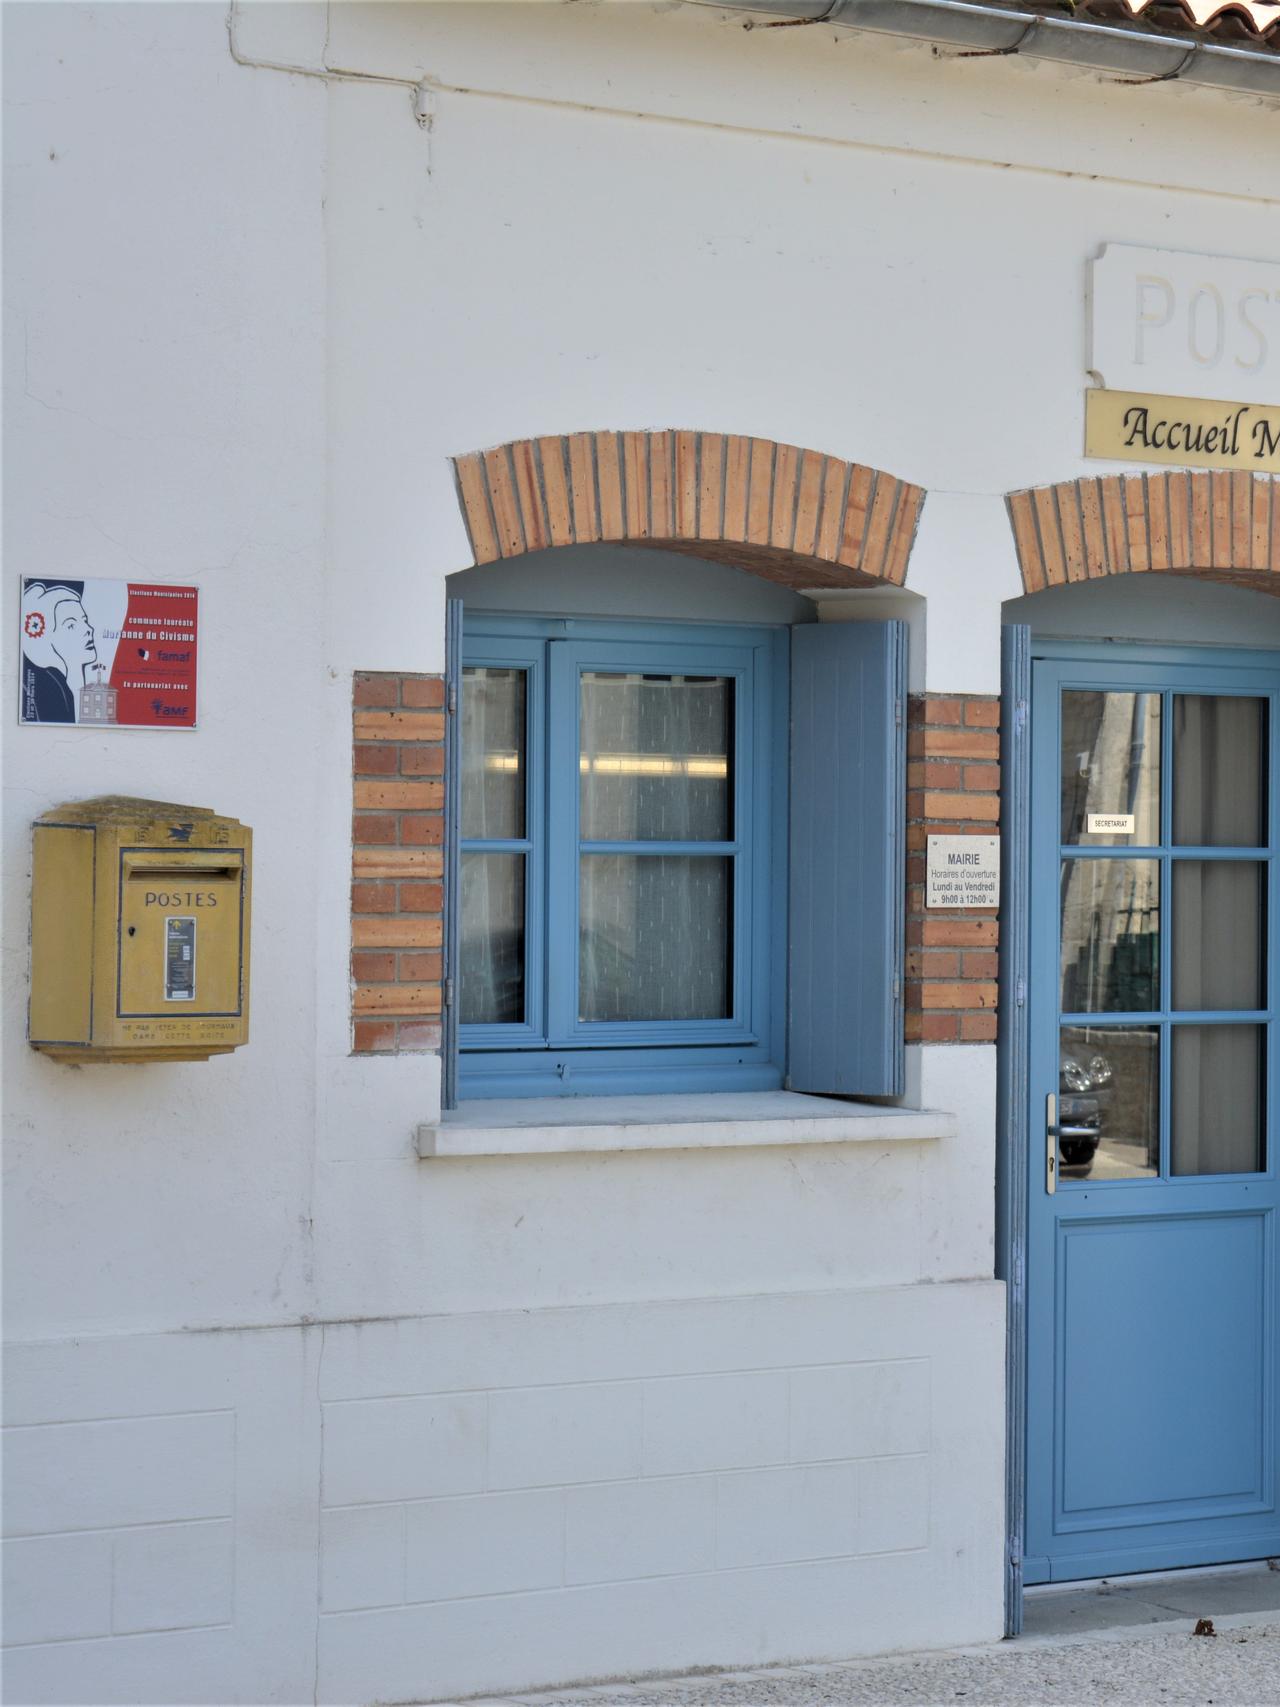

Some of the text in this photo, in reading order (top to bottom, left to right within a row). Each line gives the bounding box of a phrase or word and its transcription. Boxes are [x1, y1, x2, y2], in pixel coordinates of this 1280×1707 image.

[1123, 407, 1250, 456] Accueil
[129, 617, 194, 627] commune lauréate
[103, 629, 194, 642] Maranne du Civisme
[133, 682, 171, 690] partenariat
[948, 854, 980, 865] MAIRIE
[932, 869, 996, 879] Horaires d'ouverture
[933, 882, 952, 891] Lundi
[965, 882, 995, 891] Vendredi
[145, 892, 217, 907] POSTES
[941, 895, 986, 903] 9h00 à 12h00
